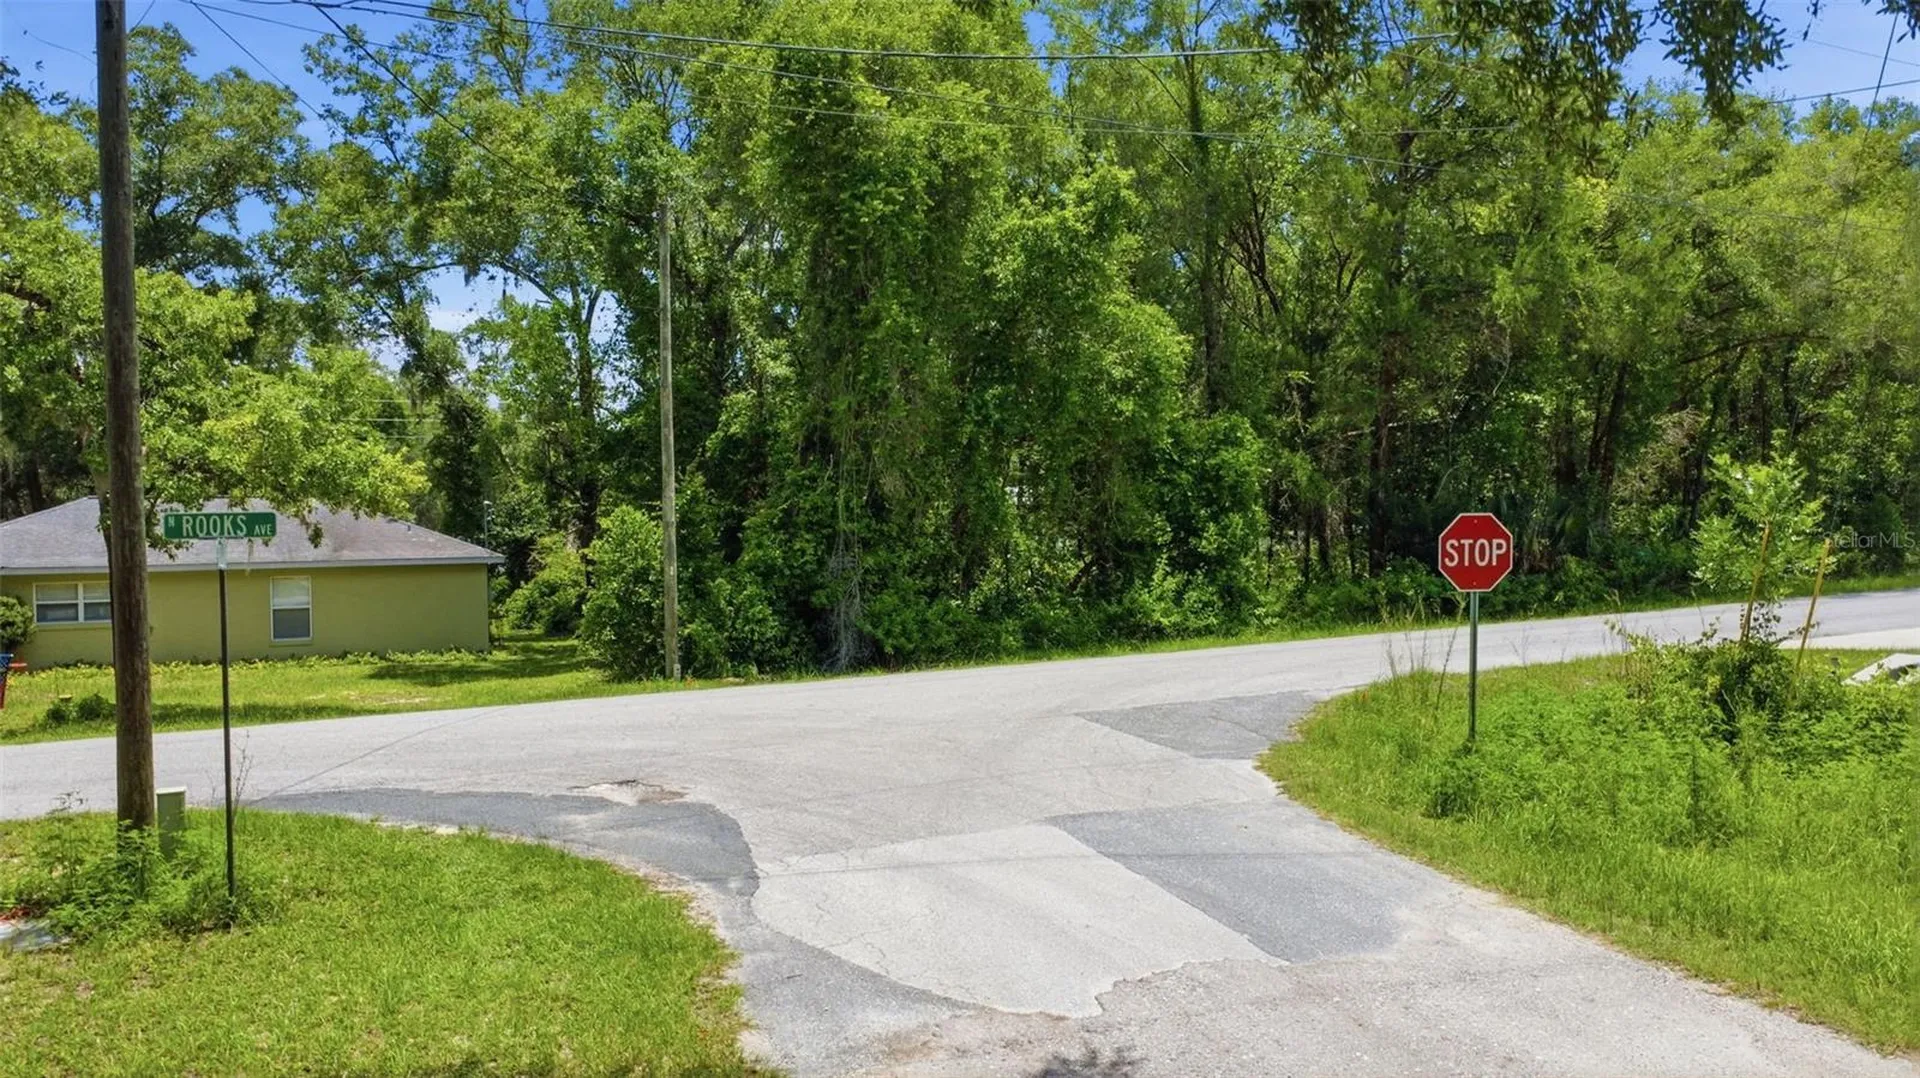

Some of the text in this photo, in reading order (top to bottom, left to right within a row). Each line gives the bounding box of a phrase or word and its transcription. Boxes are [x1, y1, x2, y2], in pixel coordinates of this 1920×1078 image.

[167, 515, 273, 537] N ROOKS AVE
[1444, 538, 1508, 567] STOP
